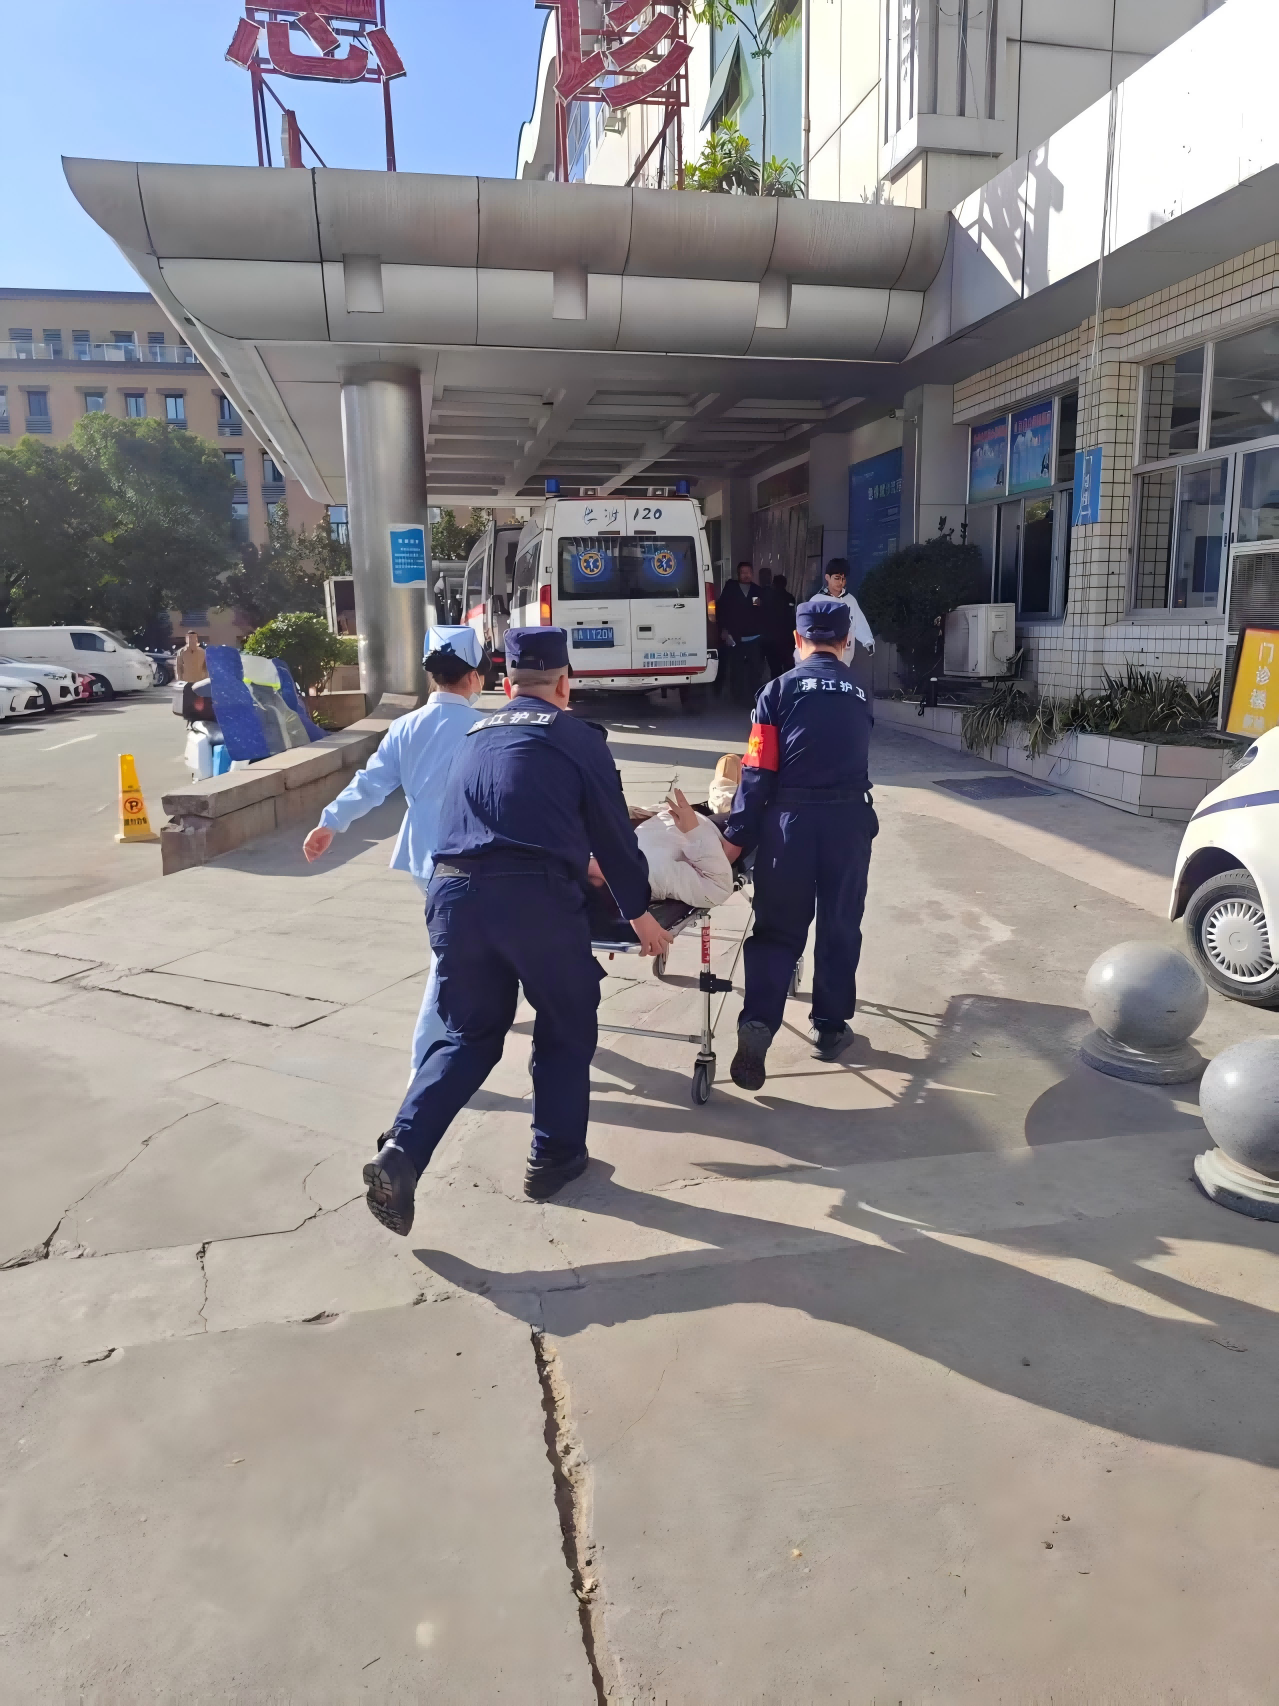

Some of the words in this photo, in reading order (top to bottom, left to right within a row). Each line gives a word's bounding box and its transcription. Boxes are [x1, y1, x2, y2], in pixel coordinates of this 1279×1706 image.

[633, 507, 663, 521] 120
[801, 678, 867, 702] 滨江护卫
